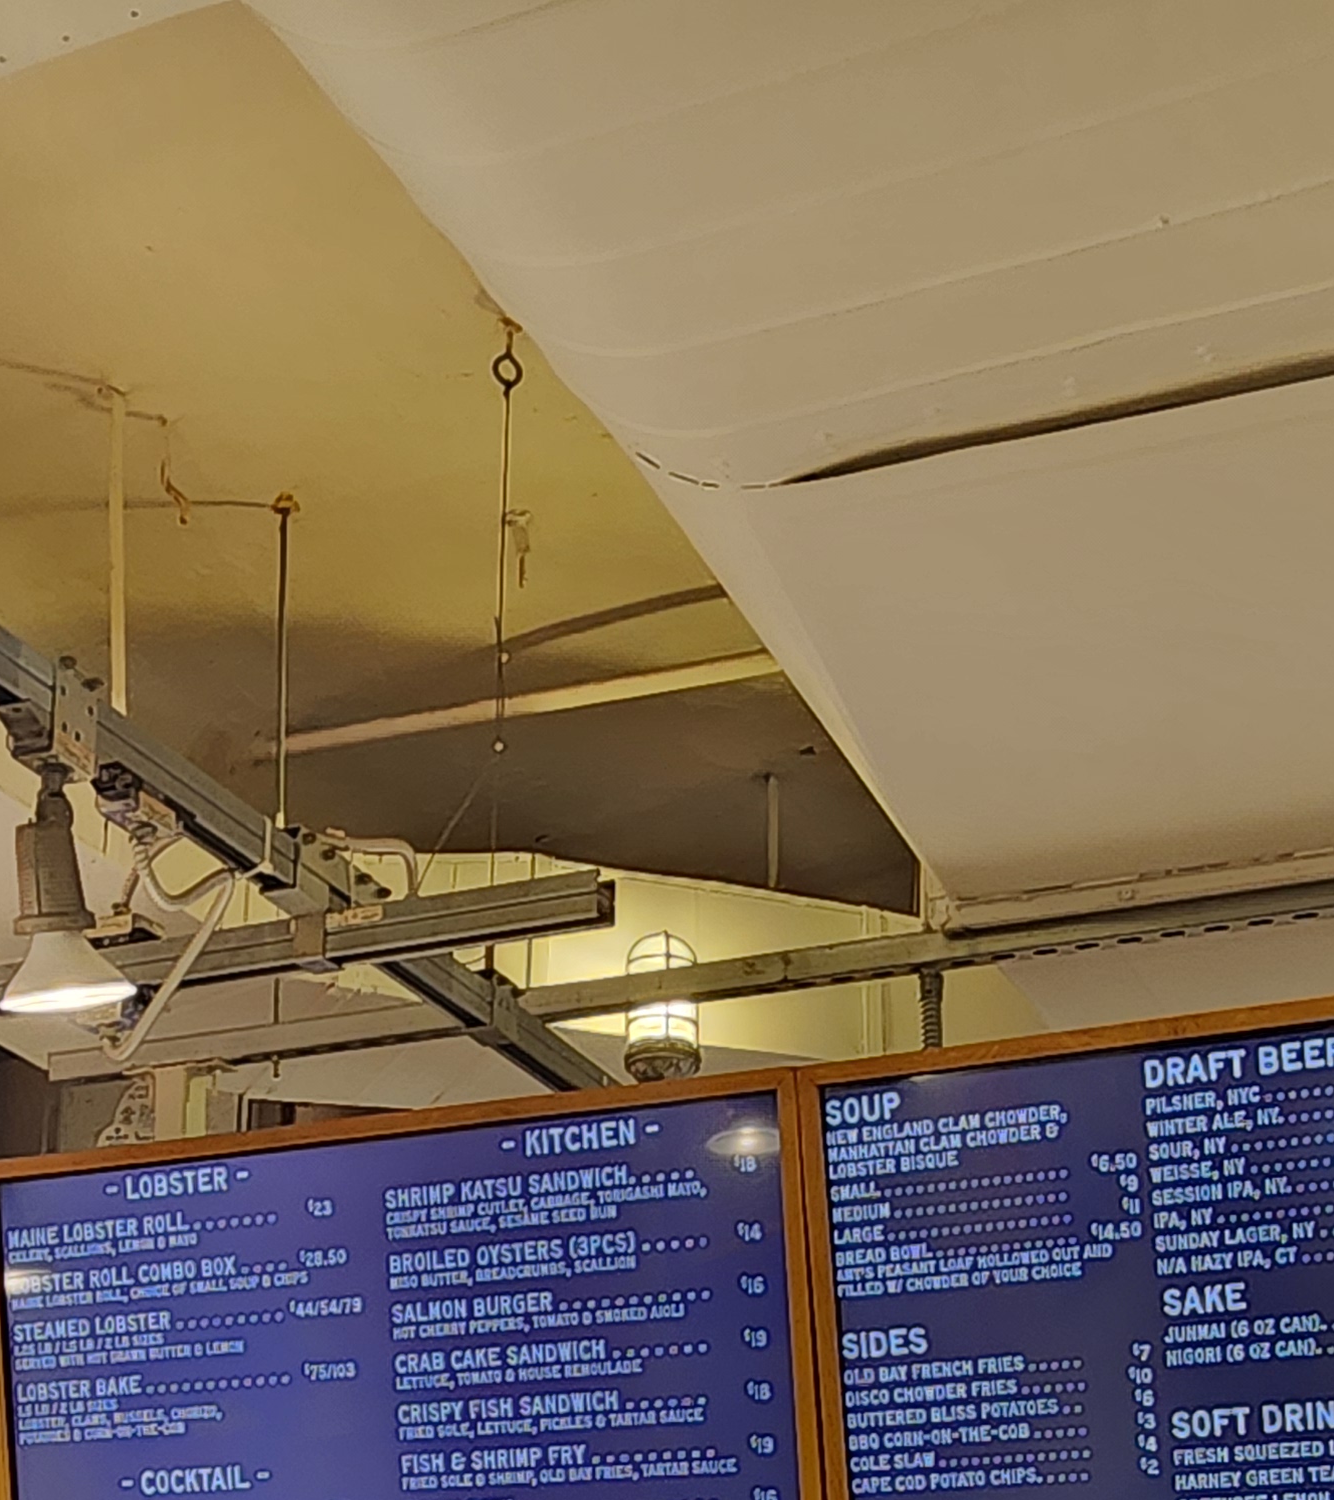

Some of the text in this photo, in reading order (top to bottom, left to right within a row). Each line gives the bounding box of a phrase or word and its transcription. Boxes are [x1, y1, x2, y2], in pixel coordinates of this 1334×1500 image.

[1144, 1049, 1246, 1088] DRAFT
[826, 1092, 900, 1126] SOUP
[526, 1119, 635, 1156] KITCHEN
[827, 1128, 858, 1145] NEW
[862, 1120, 934, 1141] ENGLAND
[938, 1114, 980, 1133] CLAM
[828, 1139, 915, 1162] MANHATTAN
[920, 1134, 961, 1152] CLAM
[966, 1125, 1041, 1147] CHOWDER
[829, 1151, 958, 1179] LOBSTER BISQUE
[1224, 1157, 1245, 1176] NY
[126, 1167, 227, 1199] LOBSTER
[385, 1183, 455, 1209] SHRIMP
[461, 1176, 521, 1202] KATSU
[833, 1202, 890, 1223] MEDIUM
[8, 1226, 59, 1249] MAINE
[63, 1218, 138, 1243] LOBSTER
[834, 1225, 884, 1244] LARGE
[1155, 1230, 1219, 1252] SUNDAY
[1293, 1221, 1315, 1239] NY
[390, 1249, 470, 1273] BROILED
[477, 1239, 563, 1265] OYSTERS
[836, 1248, 886, 1267] BREAD
[1157, 1257, 1187, 1275] N/A
[1191, 1252, 1233, 1271] HAZY
[906, 1273, 968, 1291] CHOWDER
[993, 1267, 1028, 1284] YOUR
[1031, 1262, 1081, 1280] CHOICE
[392, 1299, 467, 1323] SALMON
[473, 1292, 552, 1317] BURGER
[1164, 1282, 1246, 1316] SAKE
[14, 1319, 90, 1342] STEAMED
[95, 1311, 170, 1334] LOBSTER
[843, 1327, 928, 1359] SIDES
[844, 1368, 875, 1385] OLD
[879, 1365, 907, 1383] BAY
[912, 1361, 973, 1379] FRENCH
[978, 1356, 1024, 1373] FRIES
[846, 1389, 889, 1407] DISCO
[894, 1383, 967, 1403] CHOWDER
[971, 1379, 1017, 1396] FRIES
[848, 1409, 926, 1428] BUTTERED
[931, 1404, 977, 1422] BLISS
[981, 1399, 1058, 1419] POTATOES
[1172, 1407, 1249, 1438] SOFT
[402, 1453, 445, 1473] FISH
[471, 1448, 542, 1470] SHRIMP
[548, 1445, 586, 1465] FRY
[850, 1454, 890, 1472] COLE
[894, 1451, 935, 1469] SLAW
[1173, 1447, 1229, 1465] FRESH
[1234, 1441, 1324, 1461] SQUEEZED
[141, 1466, 251, 1494] COCKTAIL
[852, 1476, 892, 1494] CAPE
[895, 1475, 927, 1491] COD
[930, 1470, 985, 1489] POTATO
[1175, 1471, 1241, 1490] HARNEY
[1246, 1467, 1304, 1486] GREEN
